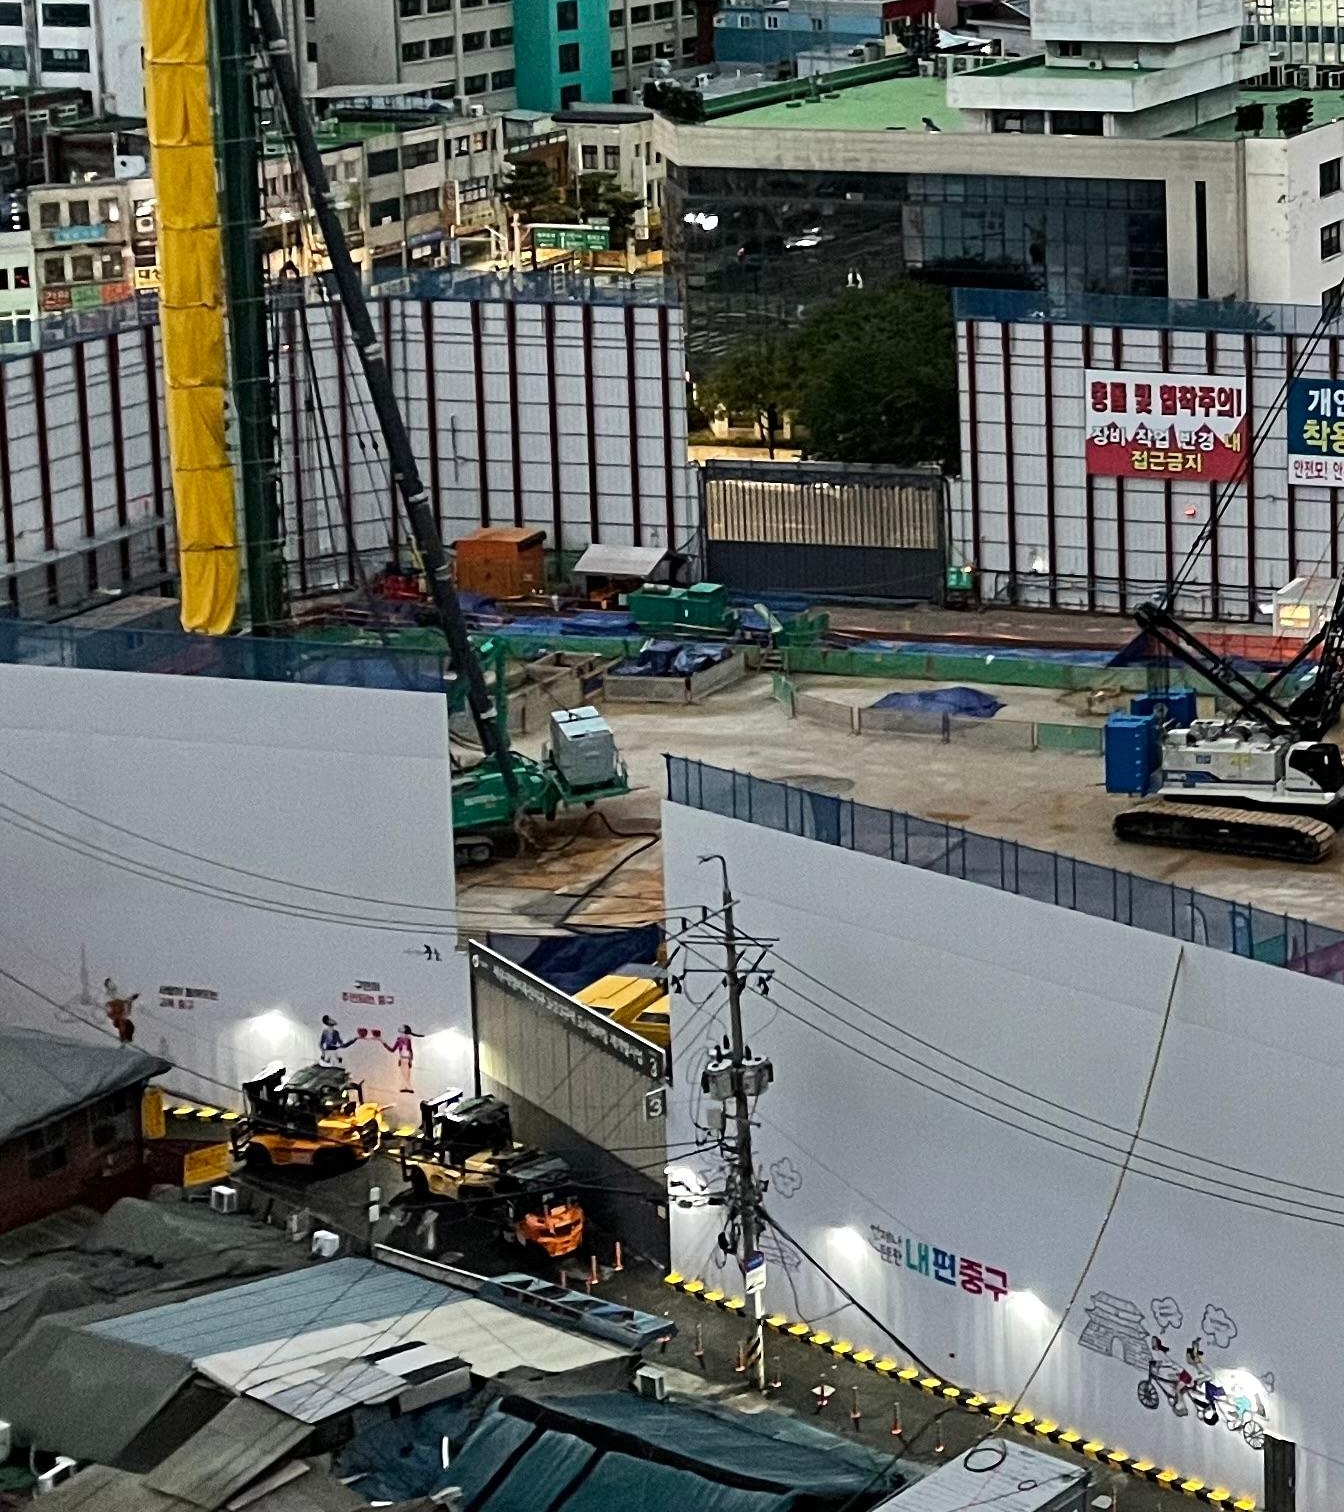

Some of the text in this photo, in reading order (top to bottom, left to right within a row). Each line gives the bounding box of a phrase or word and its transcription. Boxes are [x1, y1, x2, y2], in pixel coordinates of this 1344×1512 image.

[1134, 383, 1152, 415] 및
[1159, 384, 1242, 419] 협착주의!
[1091, 425, 1241, 453] 장비 작업 반경 내
[1131, 450, 1203, 473] 접근금지
[1293, 460, 1328, 481] 안전모!
[649, 1099, 662, 1118] 3
[905, 1238, 1008, 1302] 내편중구
